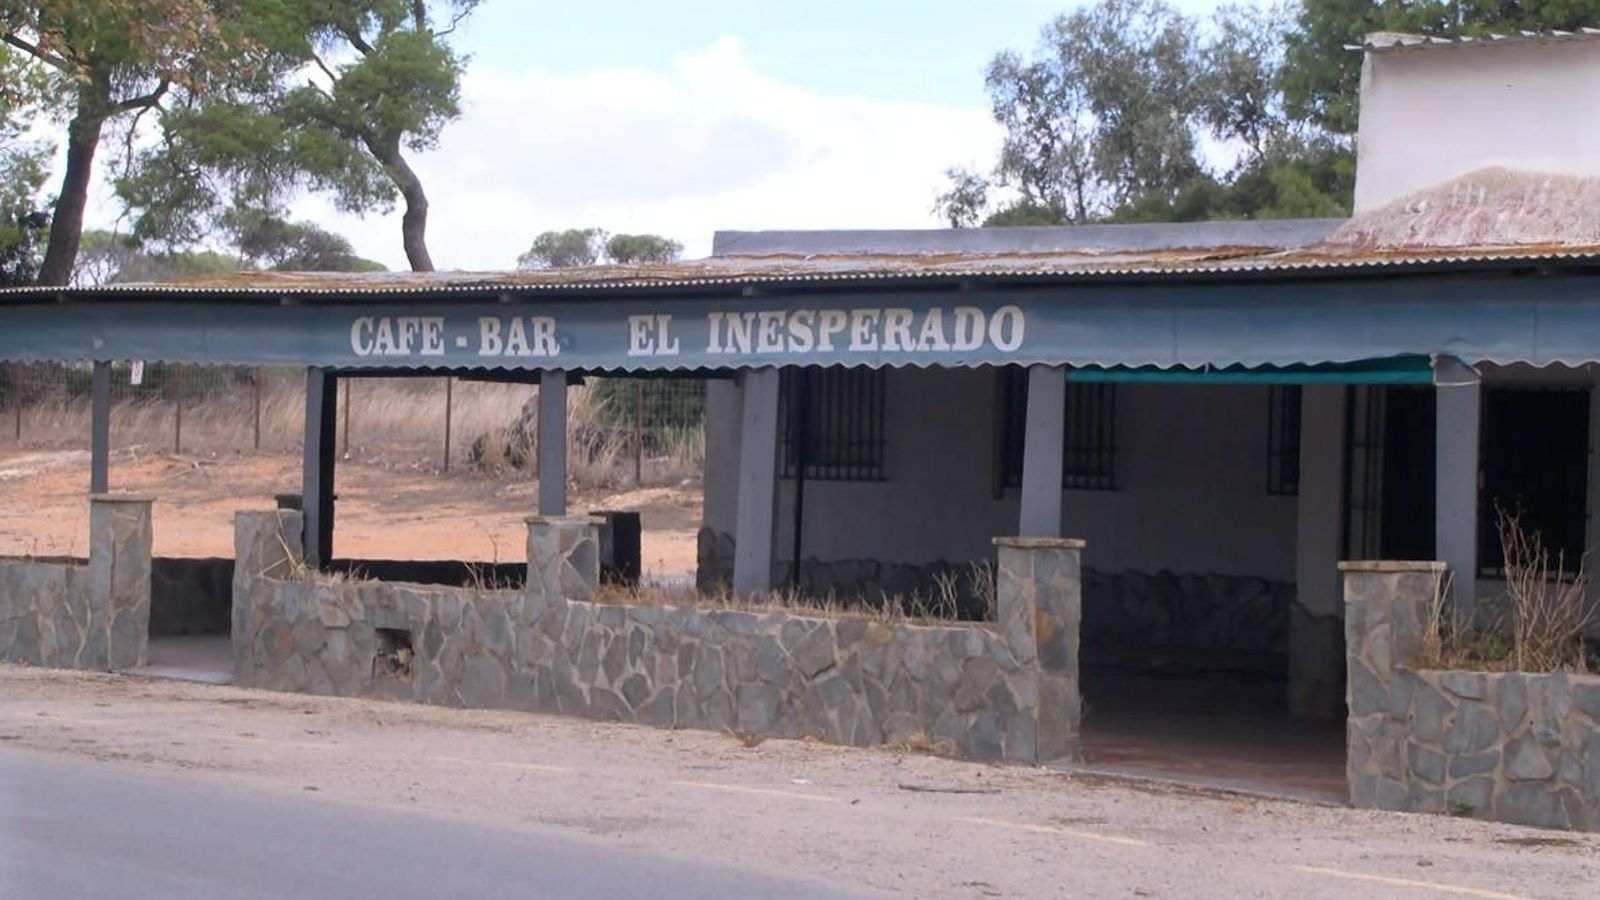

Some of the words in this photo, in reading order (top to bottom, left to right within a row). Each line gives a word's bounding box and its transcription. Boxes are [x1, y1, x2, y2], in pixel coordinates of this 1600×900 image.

[350, 316, 445, 357] CAFE
[478, 316, 560, 357] BAR
[627, 315, 680, 356] EL
[706, 305, 1026, 354] INESPERADO
